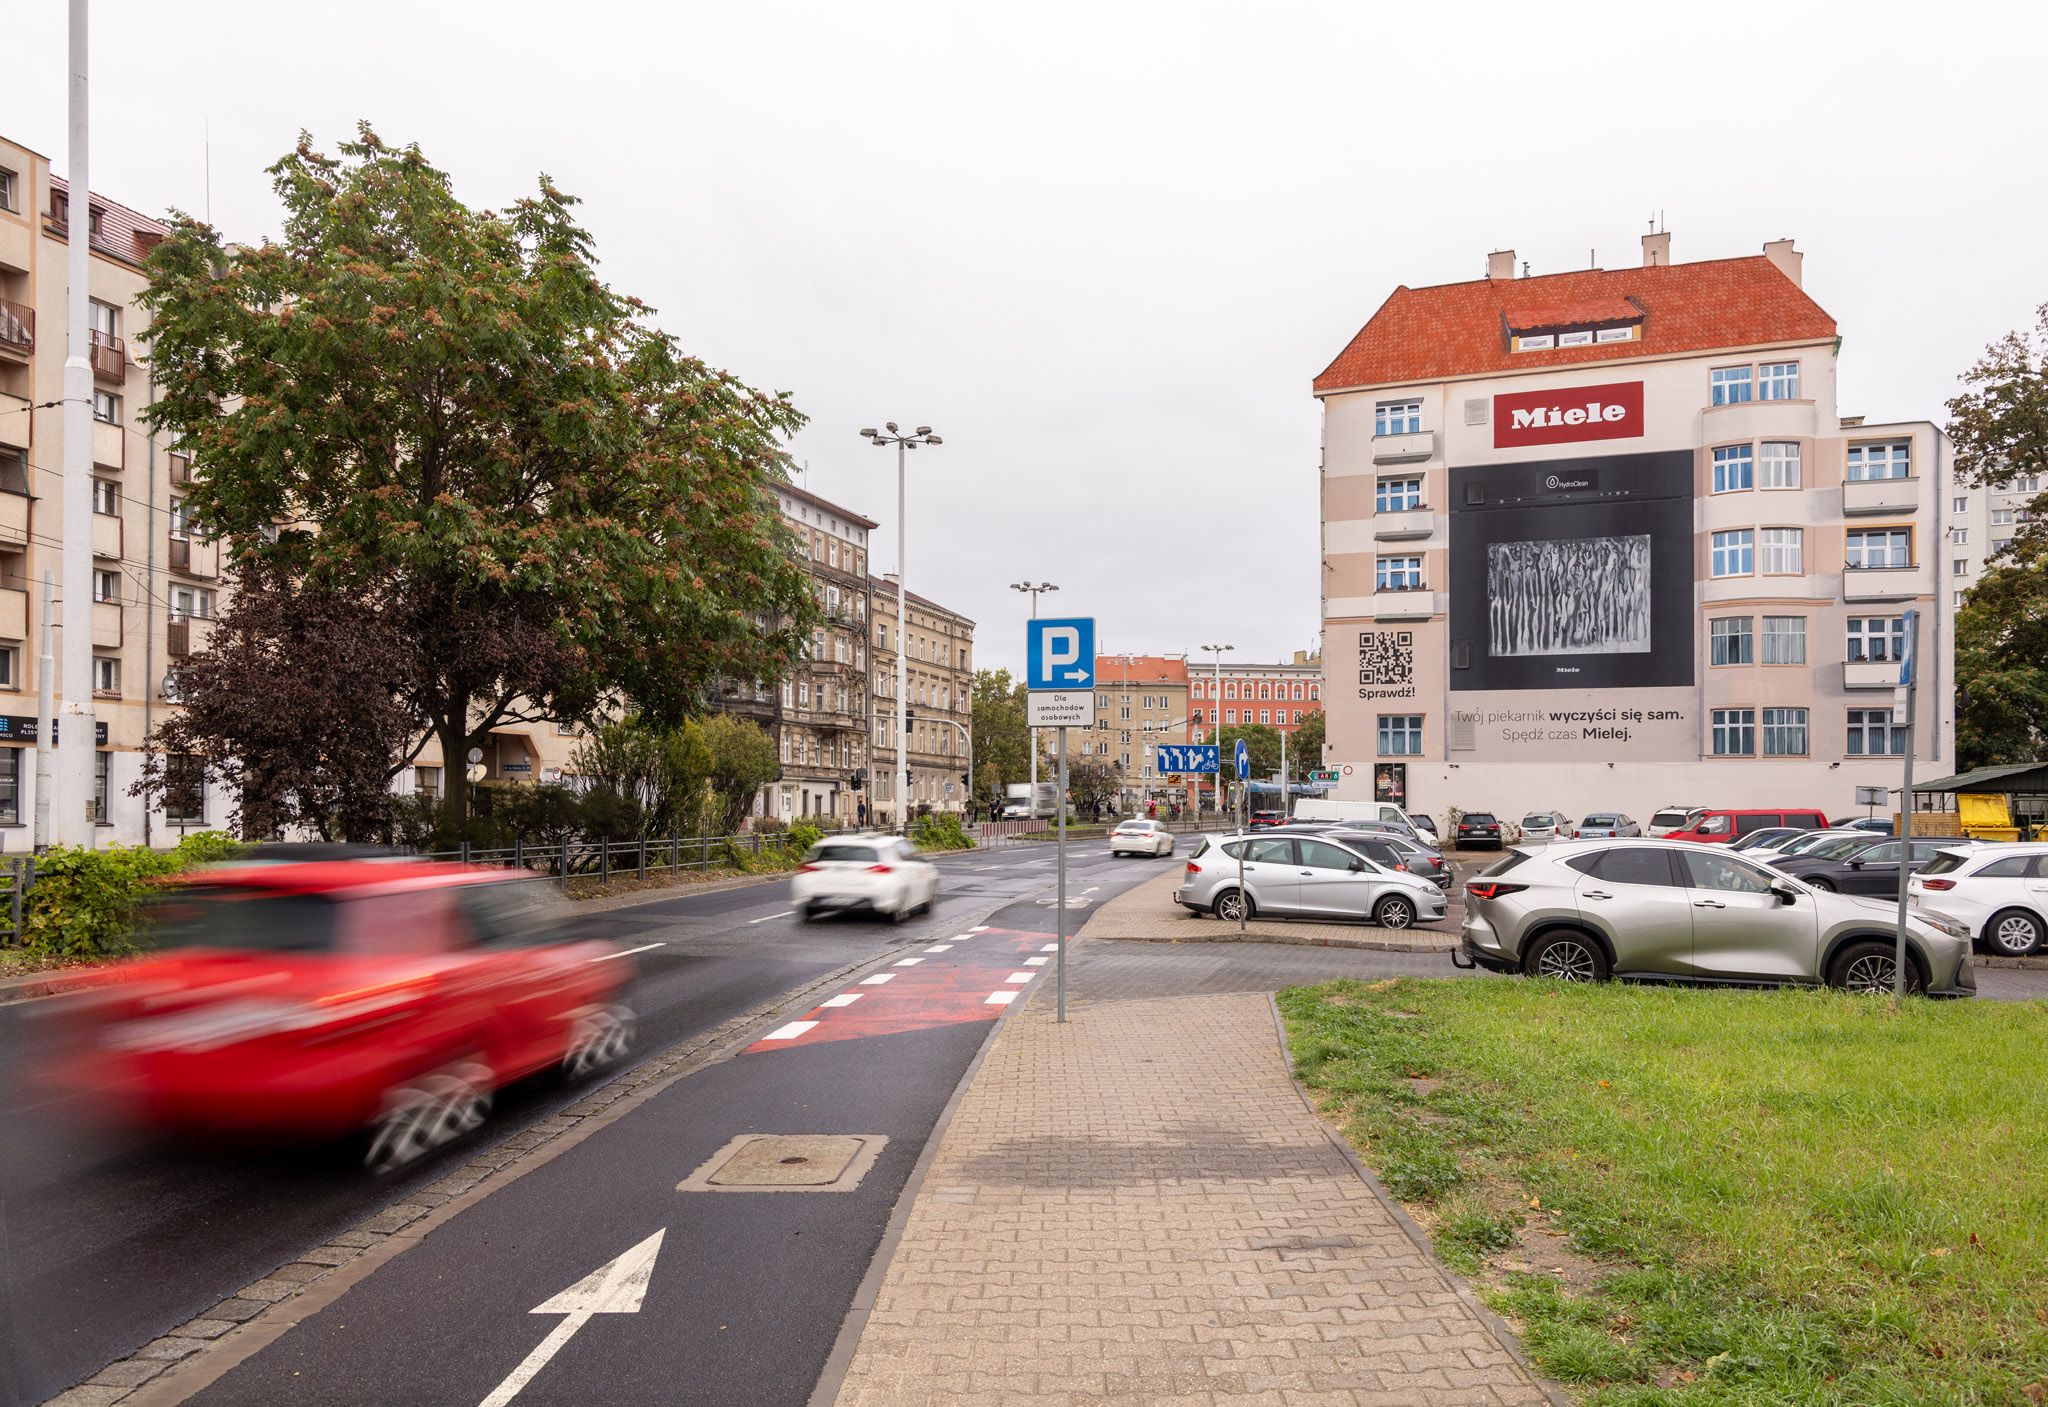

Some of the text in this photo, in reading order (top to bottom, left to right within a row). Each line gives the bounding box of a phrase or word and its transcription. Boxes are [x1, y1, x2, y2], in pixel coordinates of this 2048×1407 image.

[1511, 402, 1626, 430] Miele
[1559, 480, 1589, 489] HydroClean
[1042, 627, 1080, 682] P
[1054, 694, 1067, 702] Dla
[1358, 686, 1416, 700] Sprawdź!
[1037, 704, 1085, 712] samochodów
[1040, 713, 1081, 722] osobowych
[1454, 707, 1685, 725] Twój piekarnik wyczyści się sam.
[1502, 727, 1632, 743] Spędź czas Mielej.
